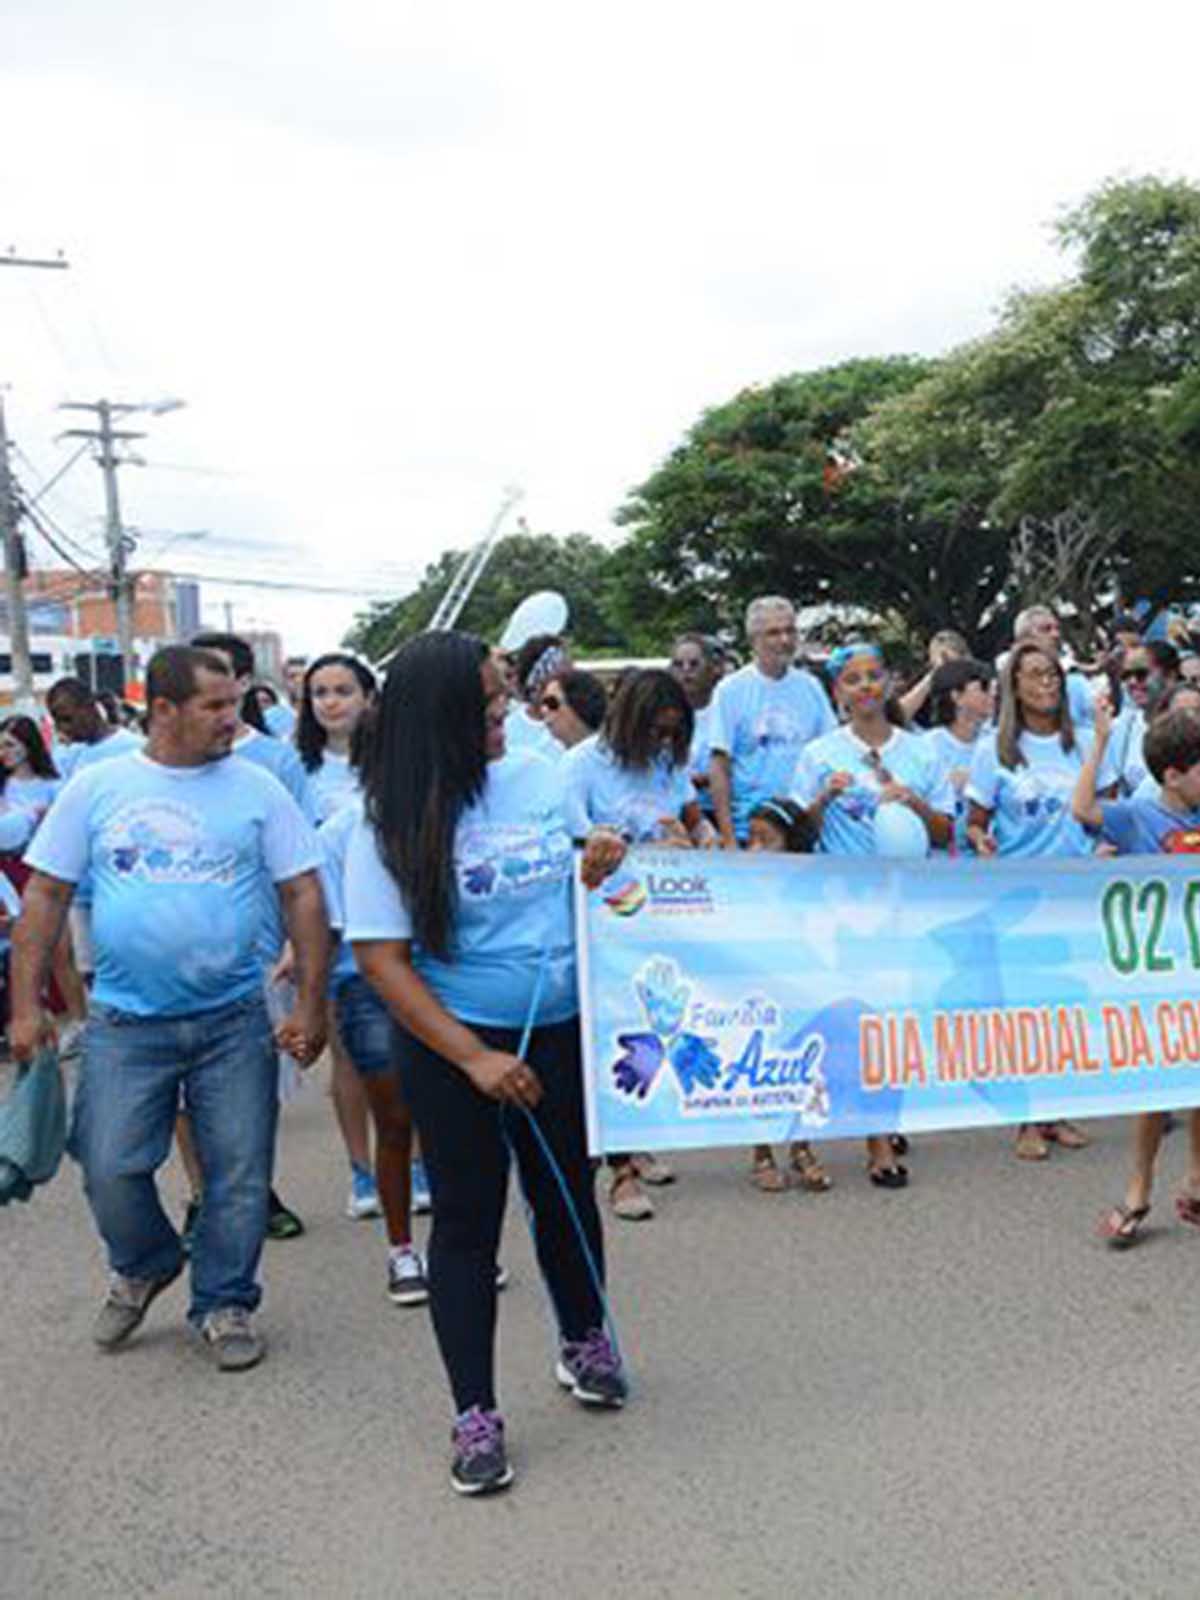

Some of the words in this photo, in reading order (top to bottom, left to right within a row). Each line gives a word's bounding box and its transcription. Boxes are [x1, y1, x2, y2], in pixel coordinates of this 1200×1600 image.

[646, 873, 709, 896] Look
[1101, 879, 1174, 975] 02
[722, 1029, 821, 1092] Azul
[860, 1014, 926, 1086] DIA
[934, 1006, 1100, 1082] MUNDIAL
[1103, 1002, 1154, 1067] DA
